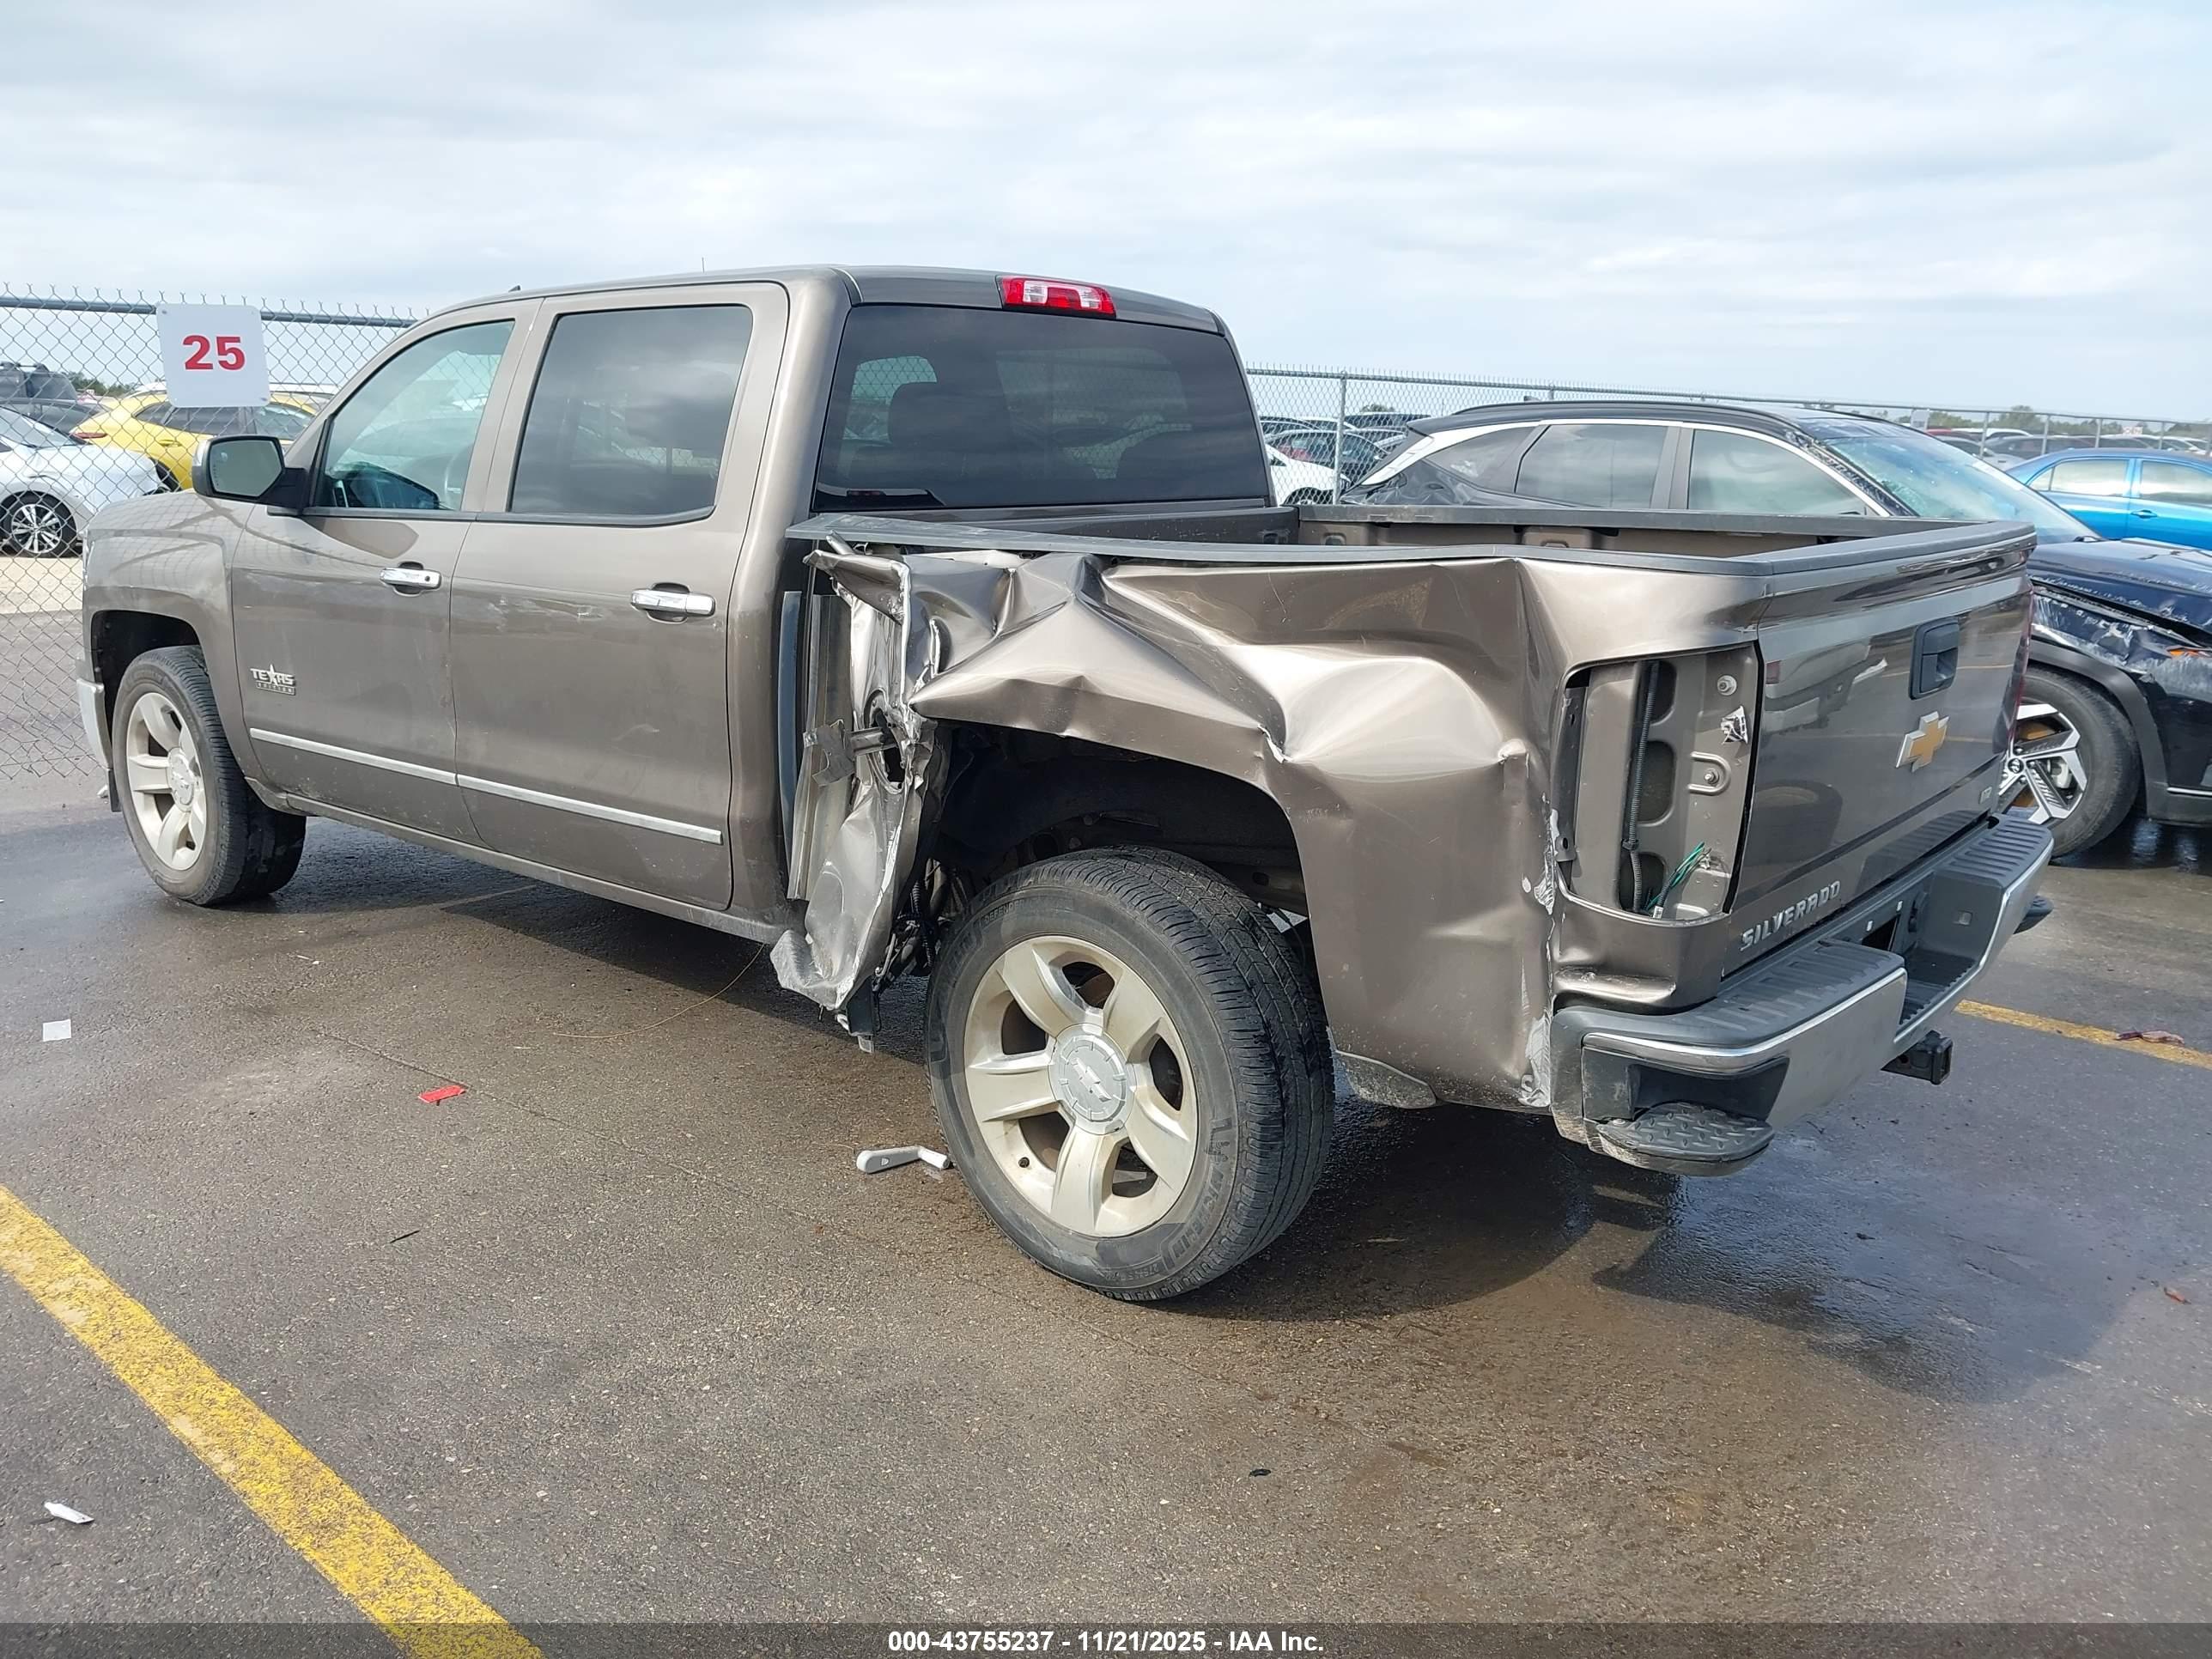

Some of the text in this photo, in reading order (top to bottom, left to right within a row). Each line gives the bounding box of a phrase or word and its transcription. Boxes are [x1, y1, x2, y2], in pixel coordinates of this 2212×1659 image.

[182, 335, 246, 371] 25
[250, 664, 295, 686] TEXAS
[1740, 880, 1840, 951] SILVERADO
